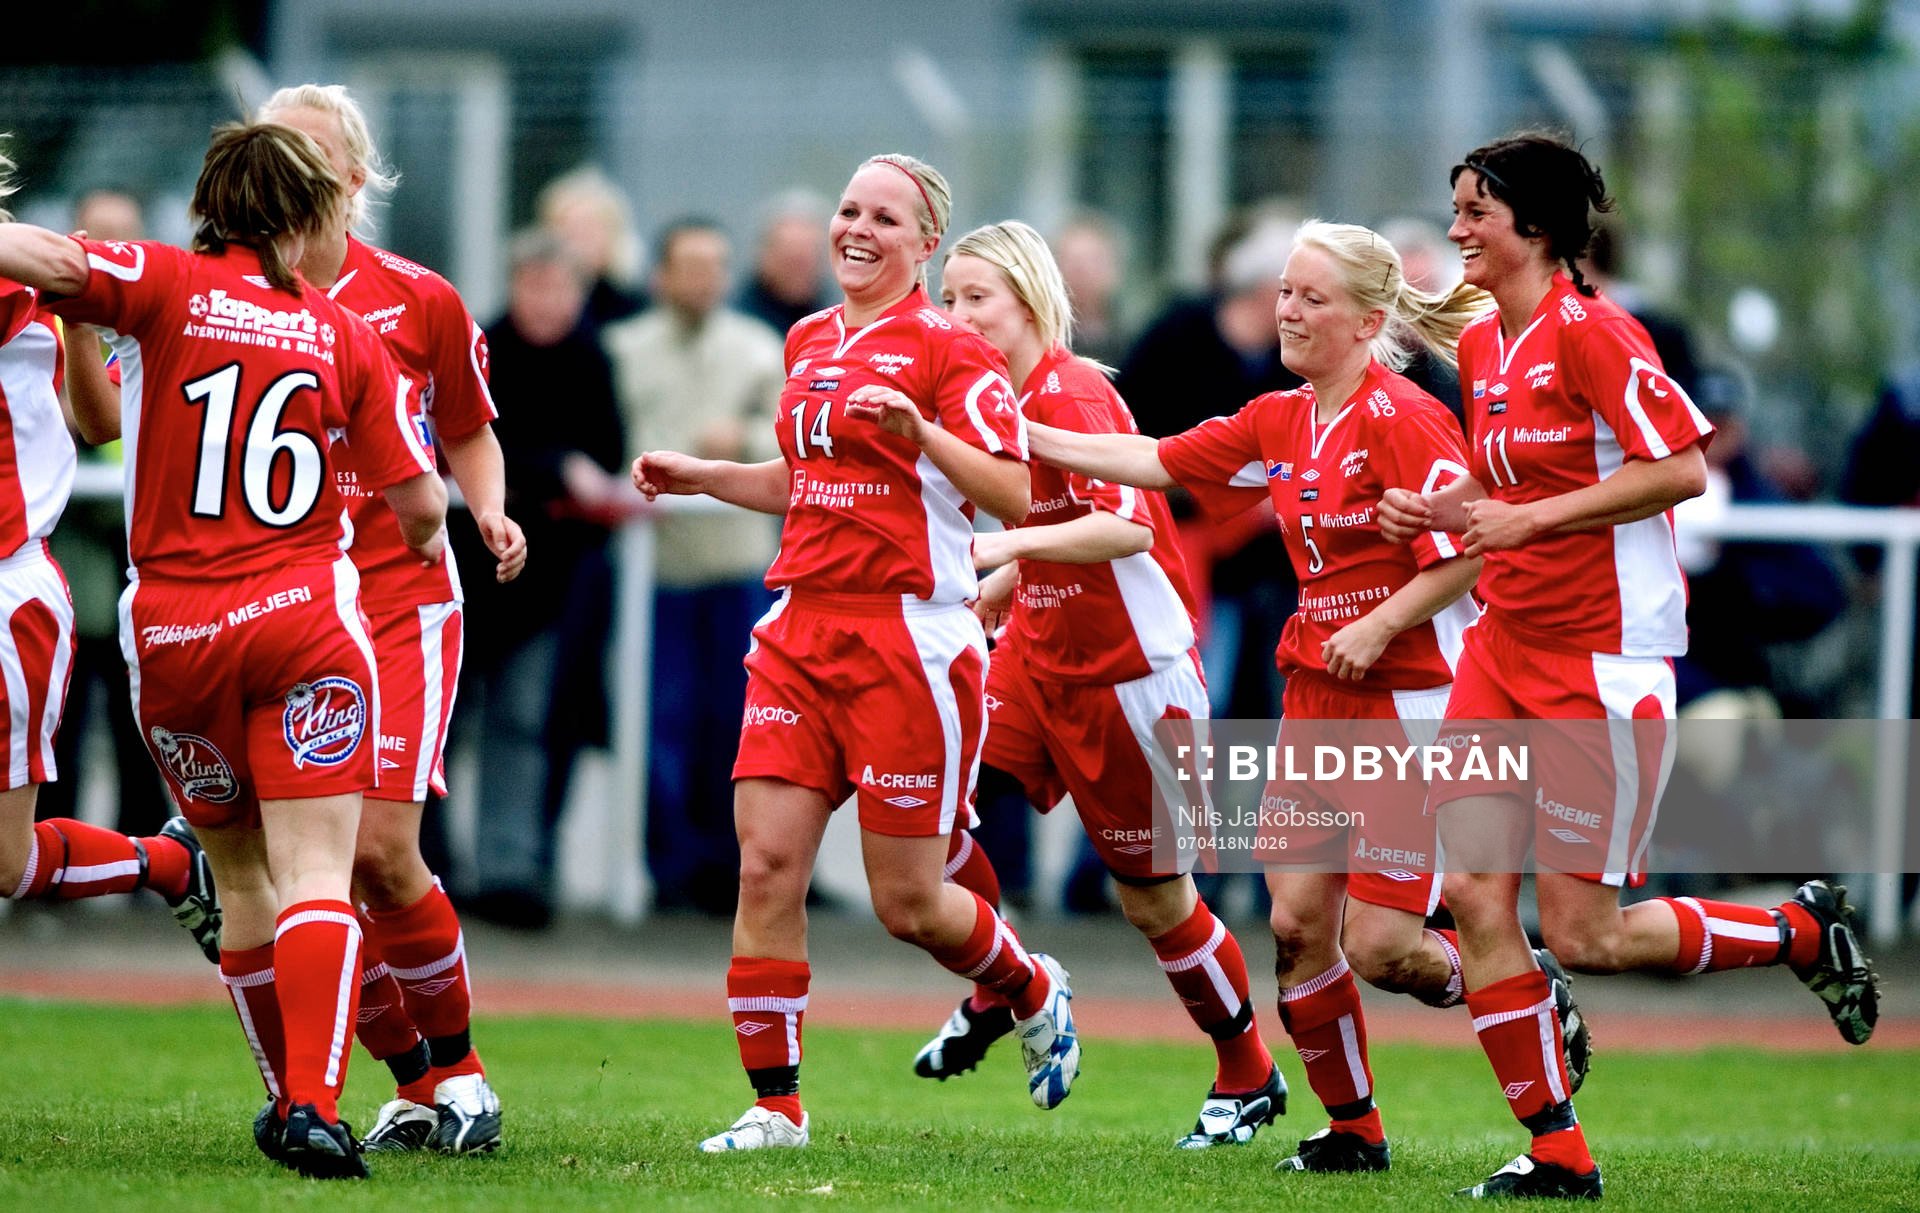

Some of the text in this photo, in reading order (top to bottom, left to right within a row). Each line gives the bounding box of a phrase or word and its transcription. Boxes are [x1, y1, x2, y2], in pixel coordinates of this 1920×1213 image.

[207, 288, 318, 334] Tapper's
[380, 318, 399, 335] KIK
[182, 320, 277, 349] ÅTERVINNING
[280, 338, 292, 351] &
[180, 358, 326, 528] 16
[790, 399, 835, 460] 14
[1482, 425, 1519, 489] 11
[1029, 491, 1070, 515] vitotal
[1300, 513, 1325, 574] 5
[227, 585, 313, 627] MEJERI
[295, 688, 359, 741] Kling
[308, 729, 350, 749] GLACE
[170, 742, 225, 779] Kling
[861, 764, 938, 789] A-CREME
[1535, 787, 1603, 829] A-CREME
[1354, 837, 1427, 867] A-CREME
